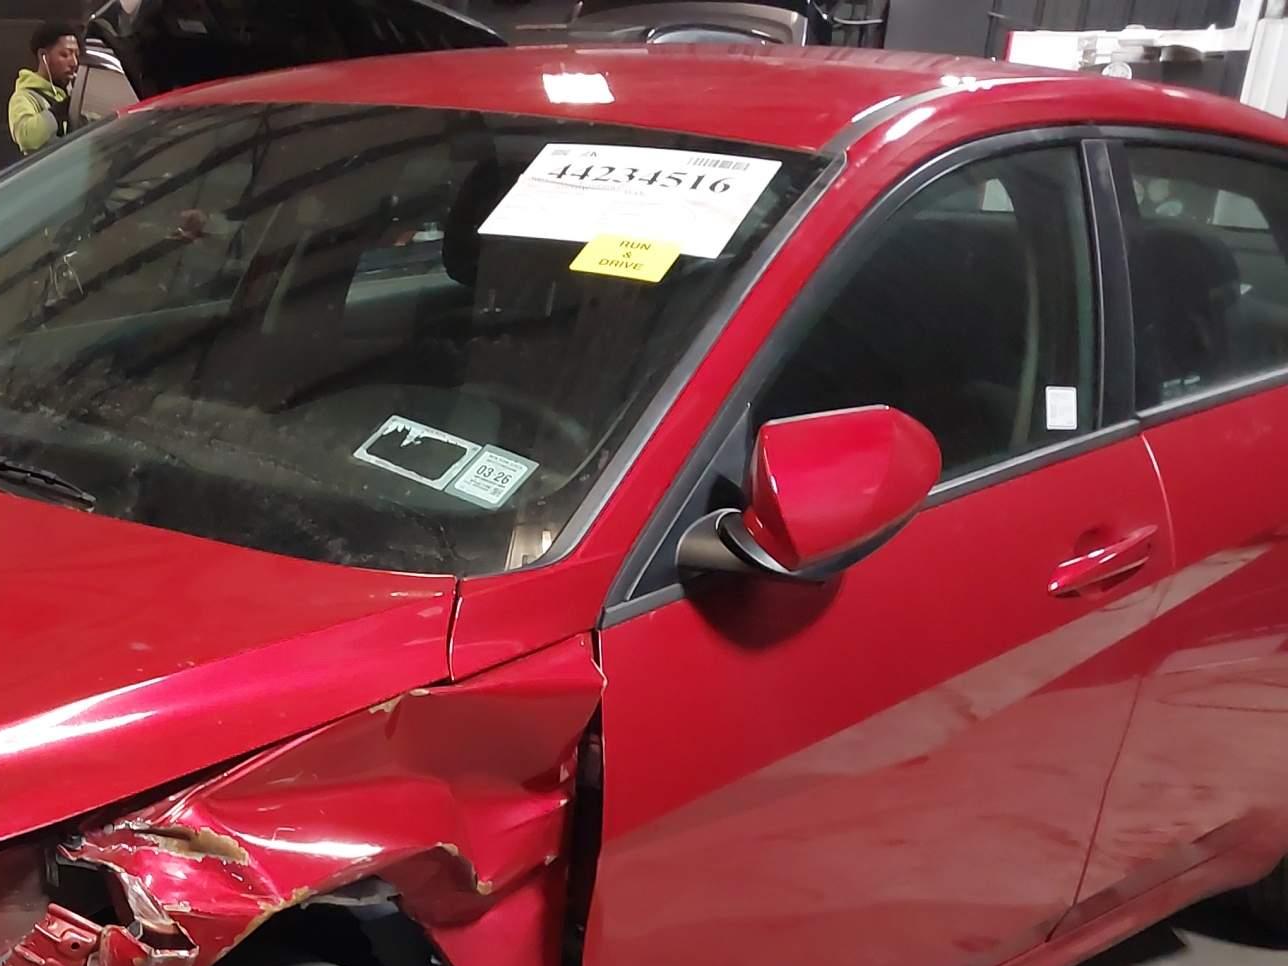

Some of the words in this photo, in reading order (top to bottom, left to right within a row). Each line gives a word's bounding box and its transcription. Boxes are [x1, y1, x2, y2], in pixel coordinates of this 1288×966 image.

[548, 163, 734, 193] 44234516
[619, 240, 652, 251] RUN
[622, 251, 633, 259] &
[598, 258, 644, 271] DRIVE
